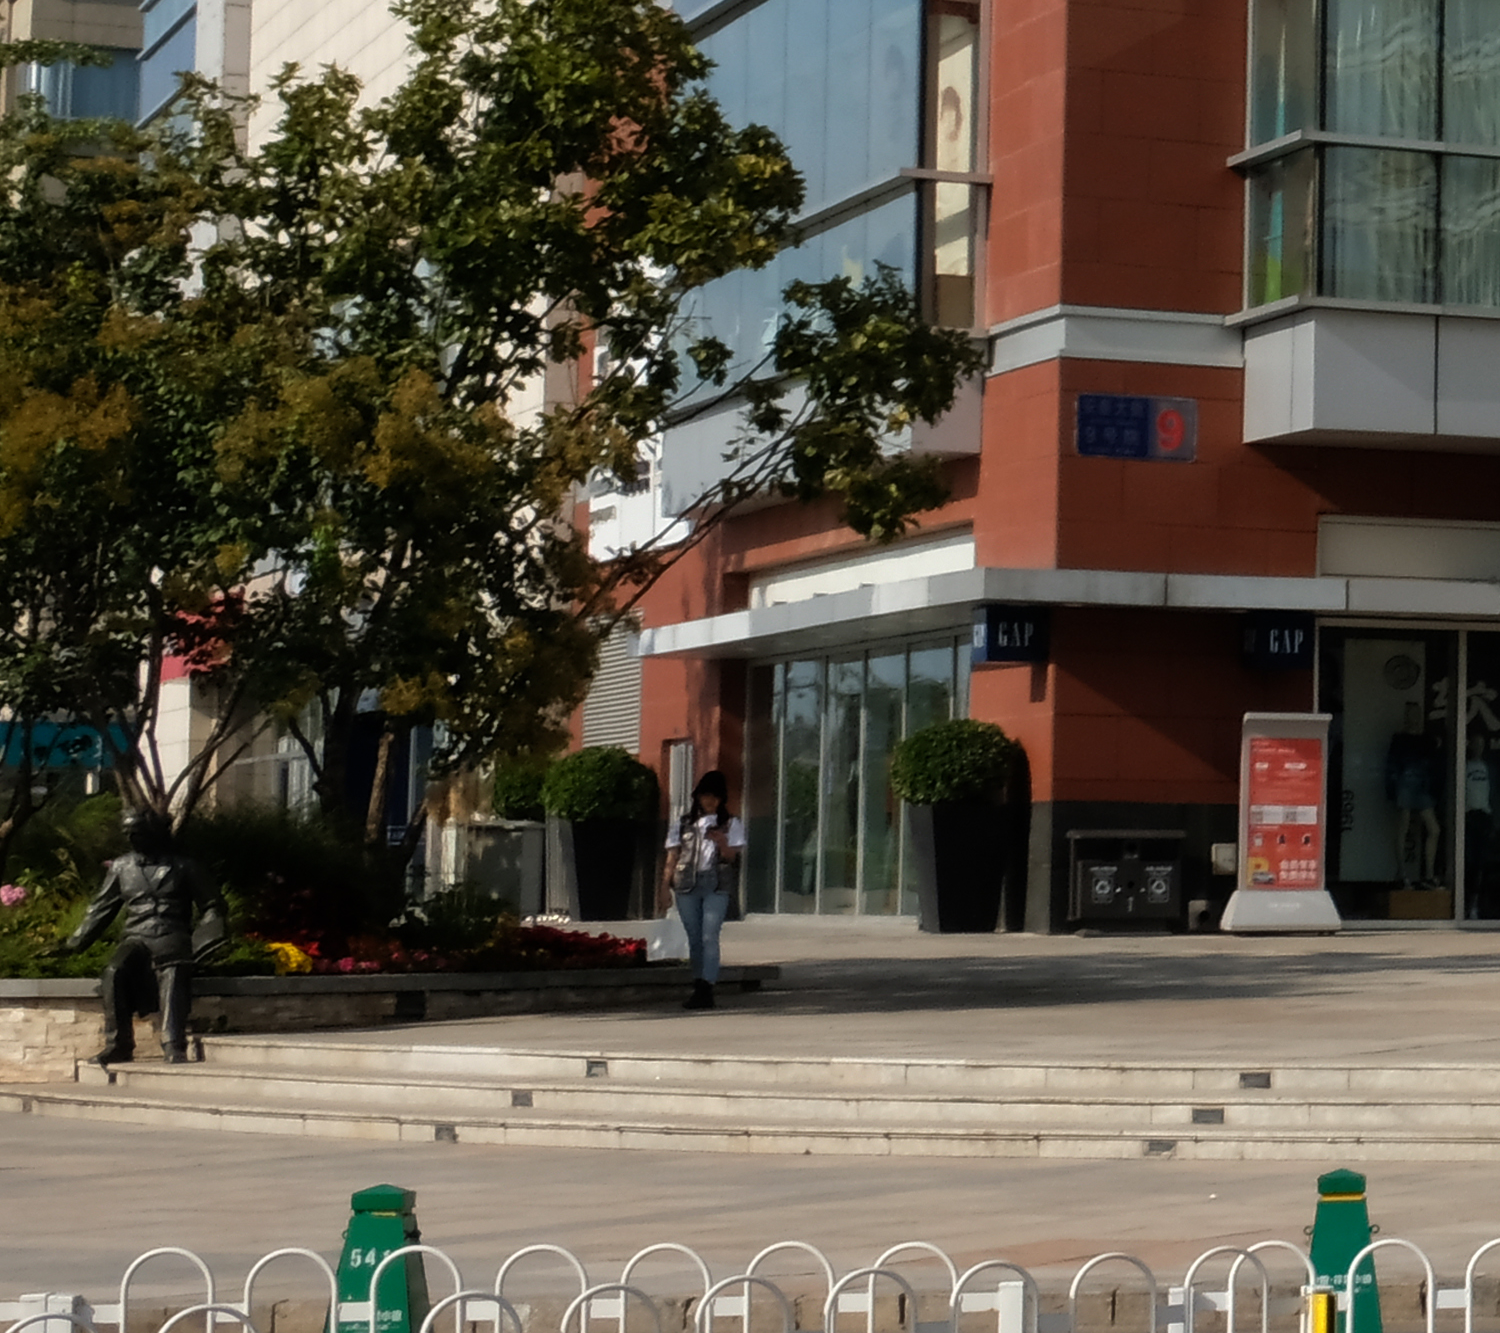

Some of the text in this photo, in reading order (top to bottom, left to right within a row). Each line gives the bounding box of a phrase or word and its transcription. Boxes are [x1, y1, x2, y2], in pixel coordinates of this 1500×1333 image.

[1156, 408, 1185, 451] 9
[998, 621, 1034, 648] GAP
[1269, 628, 1304, 654] GAP
